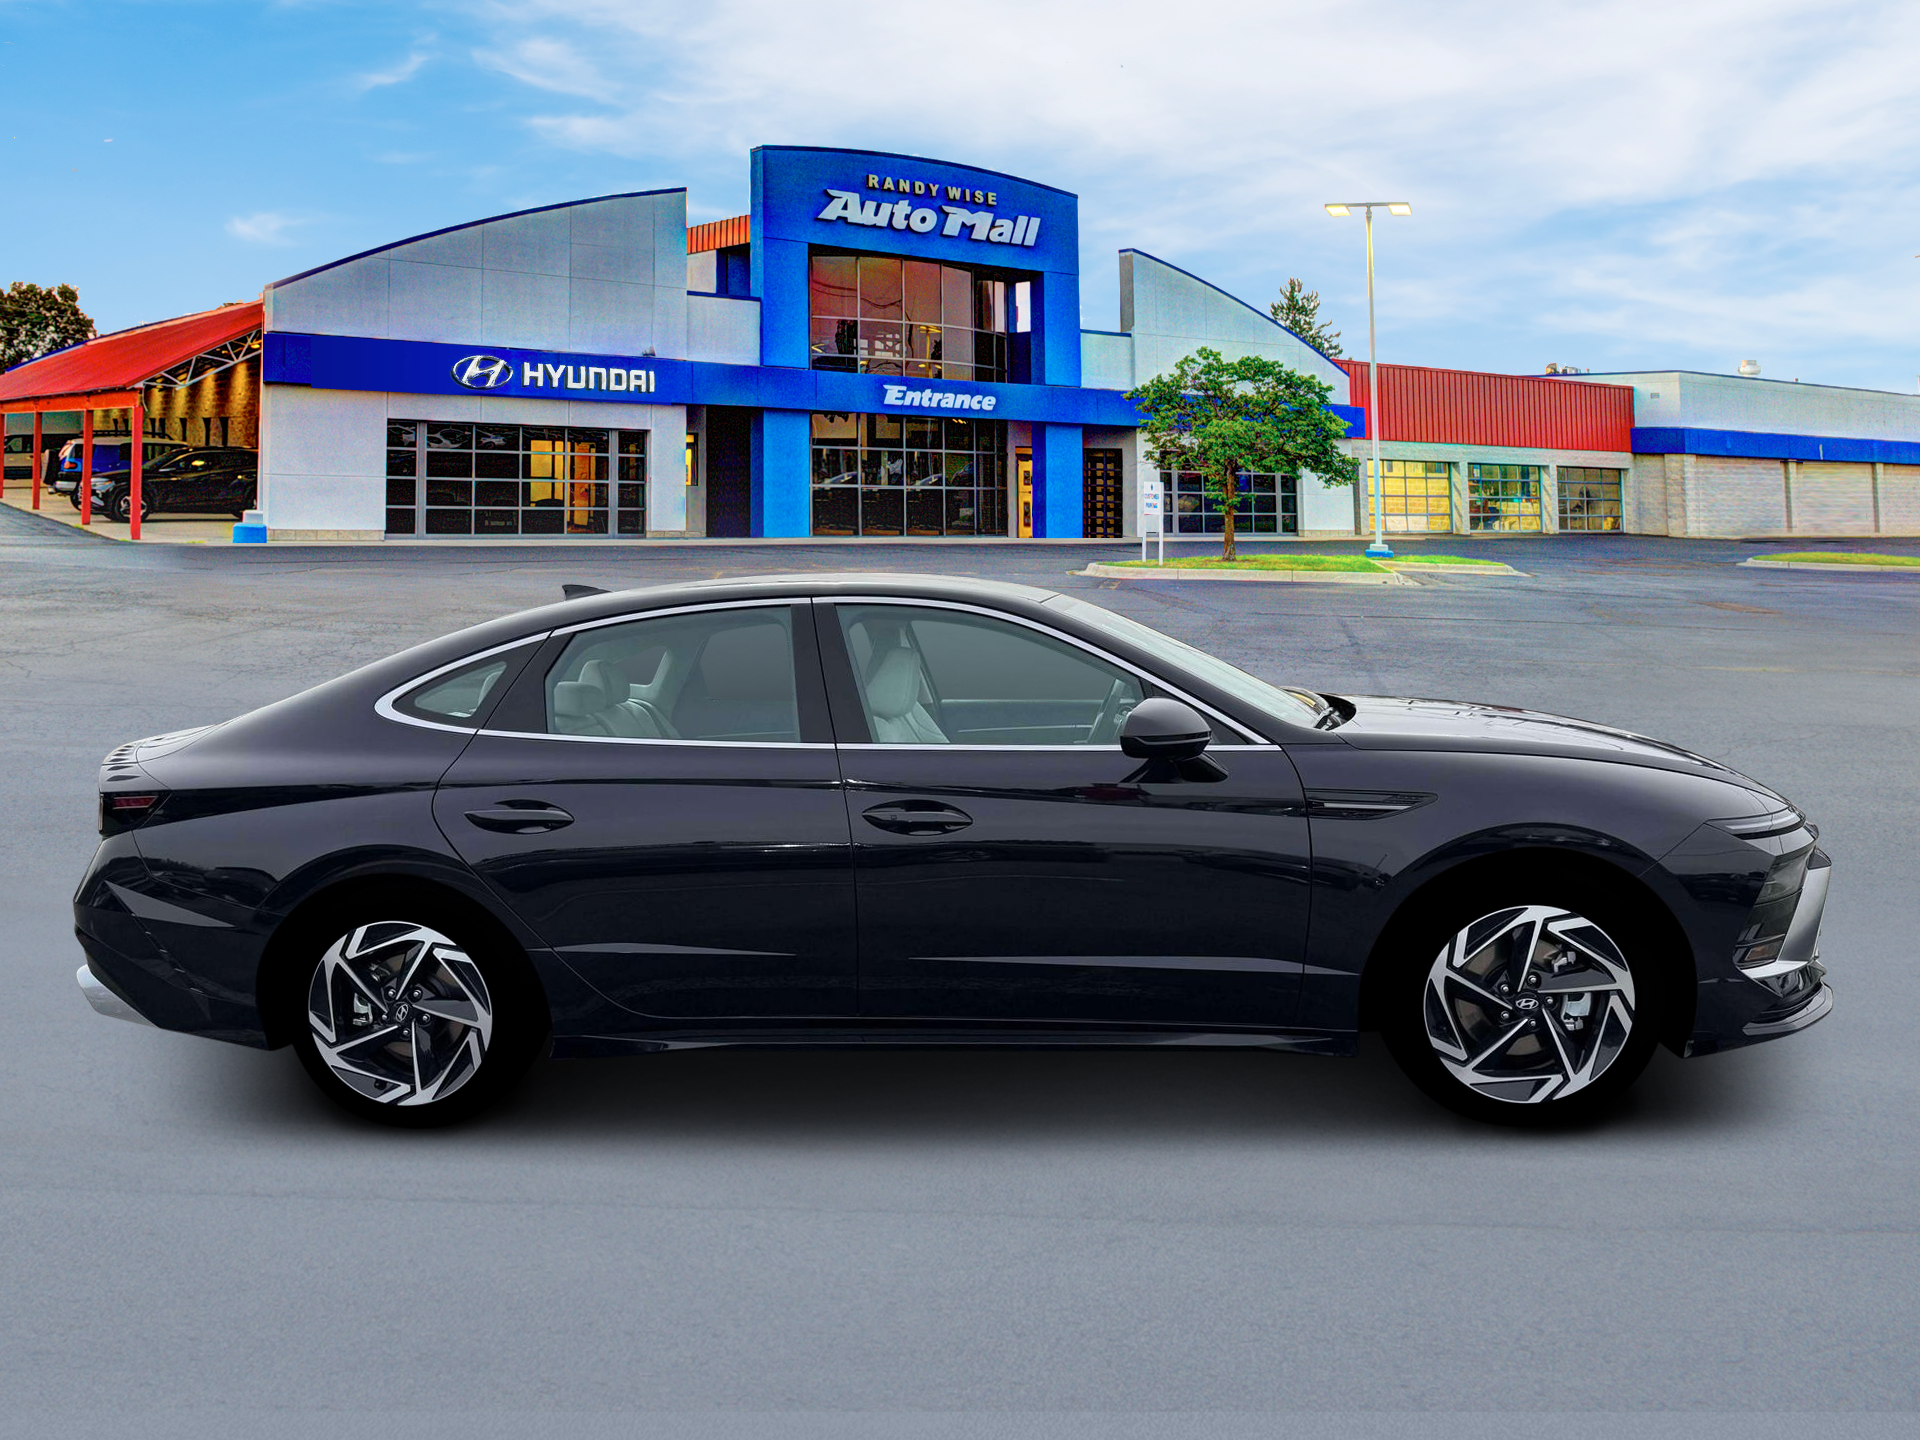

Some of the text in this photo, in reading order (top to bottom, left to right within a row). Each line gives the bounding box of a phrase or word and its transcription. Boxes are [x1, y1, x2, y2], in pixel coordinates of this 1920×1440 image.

[867, 174, 998, 205] RANDY WISE
[817, 189, 1041, 247] Auto Mall
[522, 361, 656, 393] HYUNDAI
[883, 384, 996, 411] Entrance
